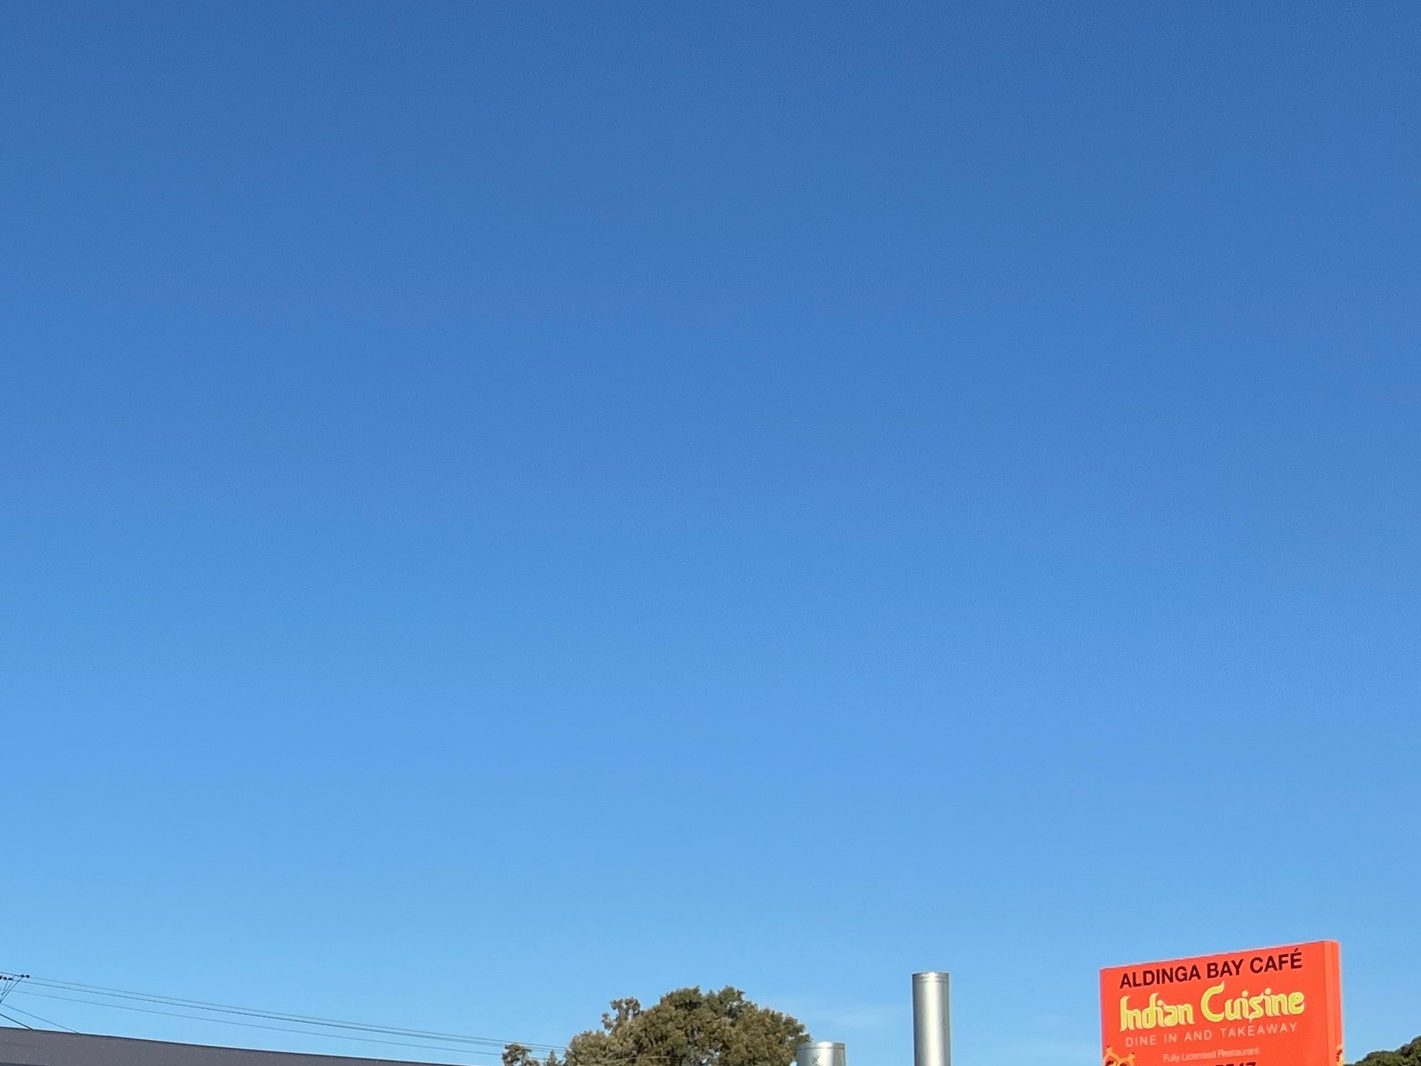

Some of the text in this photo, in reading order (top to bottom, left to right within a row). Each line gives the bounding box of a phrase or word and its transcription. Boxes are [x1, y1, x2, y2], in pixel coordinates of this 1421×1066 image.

[1119, 948, 1302, 989] ALDINGA BAY CAFÉ
[1119, 981, 1305, 1032] Indian Cuisine
[1125, 1022, 1298, 1048] DINE IN AND TAKEAWAY
[1163, 1053, 1180, 1063] Fully
